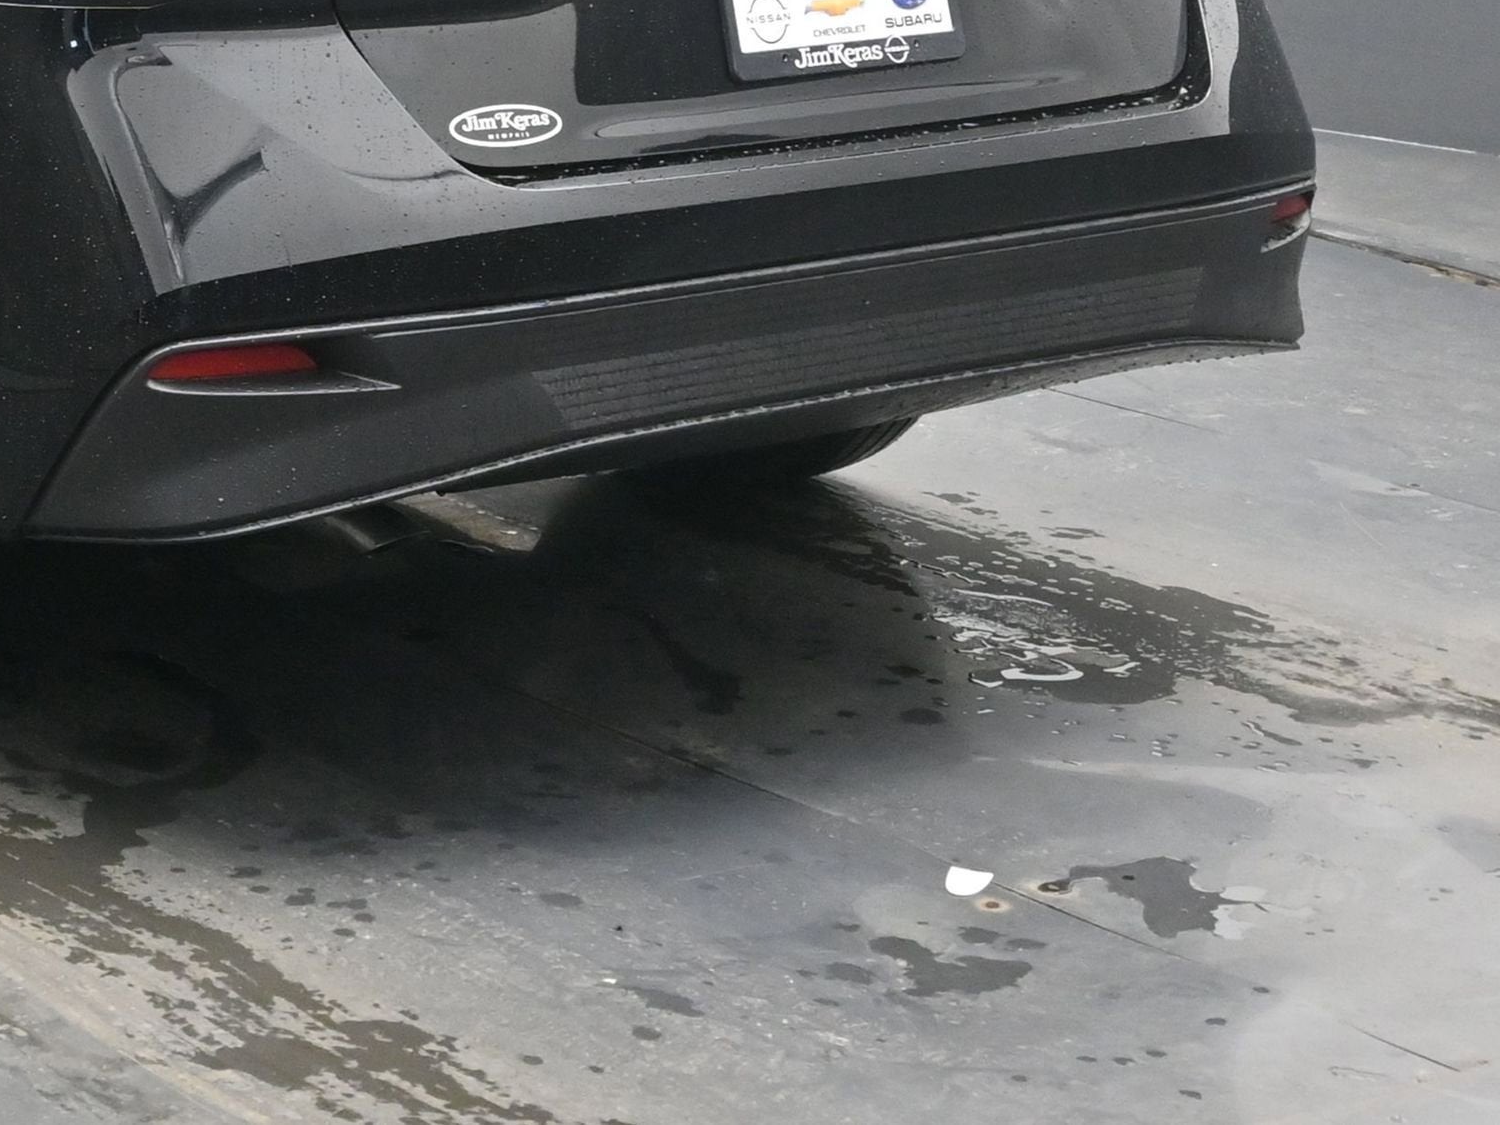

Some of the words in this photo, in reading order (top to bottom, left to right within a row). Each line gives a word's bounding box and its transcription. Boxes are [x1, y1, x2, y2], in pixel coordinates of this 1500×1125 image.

[746, 11, 791, 24] NISSAN
[884, 13, 943, 29] SUBARU
[813, 24, 867, 38] CHEVROLET
